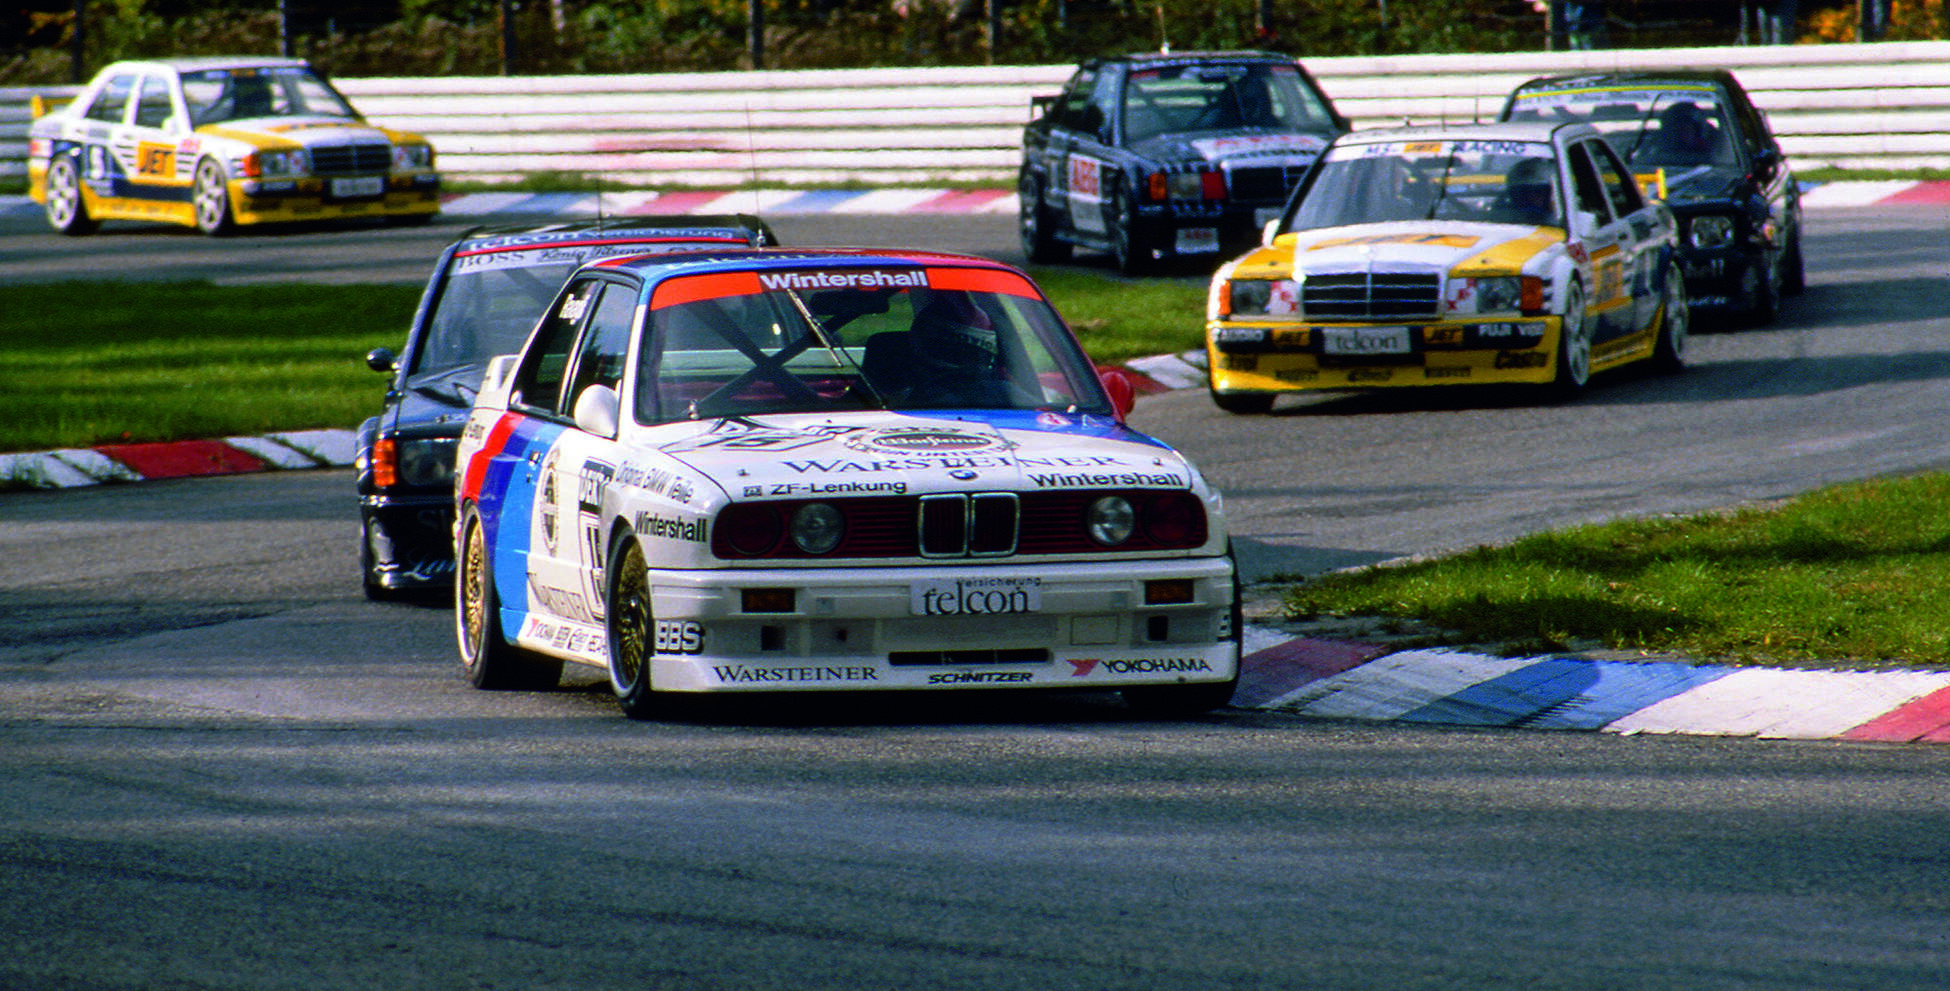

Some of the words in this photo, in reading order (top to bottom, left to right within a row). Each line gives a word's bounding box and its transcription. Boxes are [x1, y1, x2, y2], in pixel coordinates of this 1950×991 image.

[139, 149, 173, 174] JET
[760, 271, 930, 291] Wintershall
[1335, 329, 1399, 351] telcon
[779, 456, 1132, 474] WARSTEINER
[769, 482, 907, 496] ZF-Lenkung
[1027, 471, 1186, 489] Wintershall
[635, 510, 709, 544] Wintershall
[923, 579, 1031, 616] telcon
[654, 618, 706, 656] BBS
[712, 664, 878, 683] WARSTEINER
[928, 671, 1034, 685] SCHNITZER
[1100, 658, 1212, 679] YOKOHAMA
